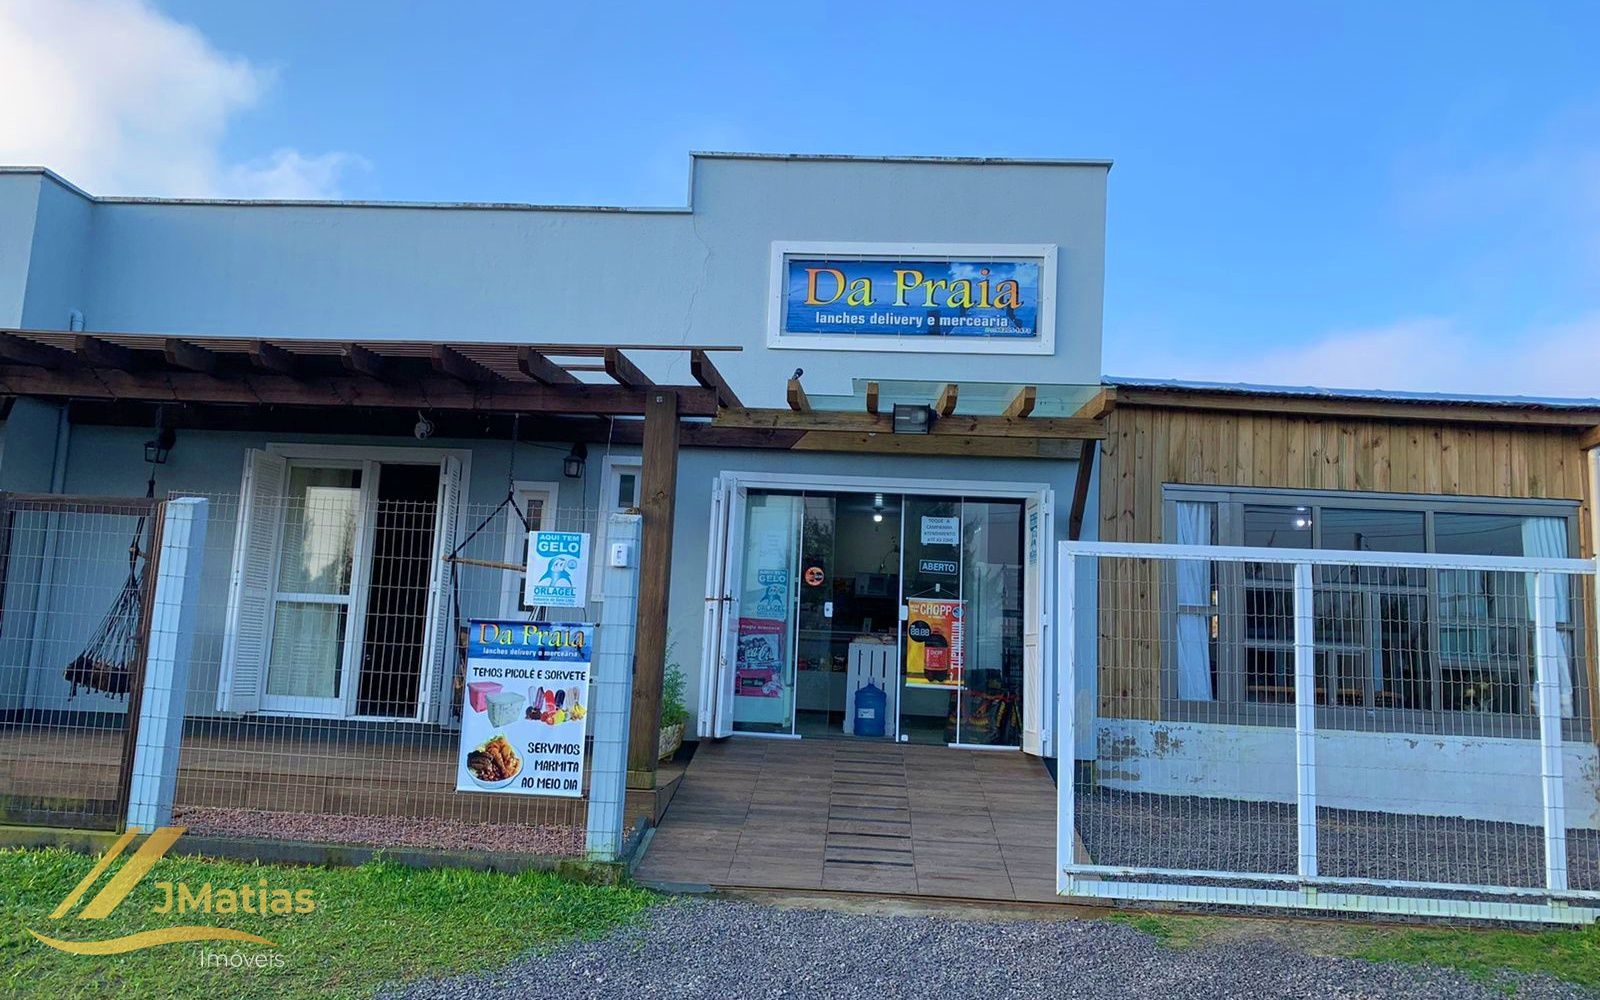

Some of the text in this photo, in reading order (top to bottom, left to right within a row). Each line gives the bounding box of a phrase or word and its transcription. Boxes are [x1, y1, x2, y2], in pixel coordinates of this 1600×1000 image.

[804, 267, 1025, 310] Da Praia
[815, 311, 1008, 328] lanches delivery e mercearia
[538, 541, 579, 553] GELO
[922, 562, 955, 572] ABERTO
[534, 587, 577, 596] ORLAGEL
[920, 603, 952, 616] CHOPP
[479, 623, 587, 648] Da Praia
[483, 647, 509, 655] lanches
[510, 648, 536, 657] delivery
[473, 667, 586, 681] TEMOS PICOLÉ E SORVETE
[527, 742, 580, 755] SERVIMOS
[534, 760, 579, 772] MARMITA
[521, 777, 578, 790] AO MEIO DIA
